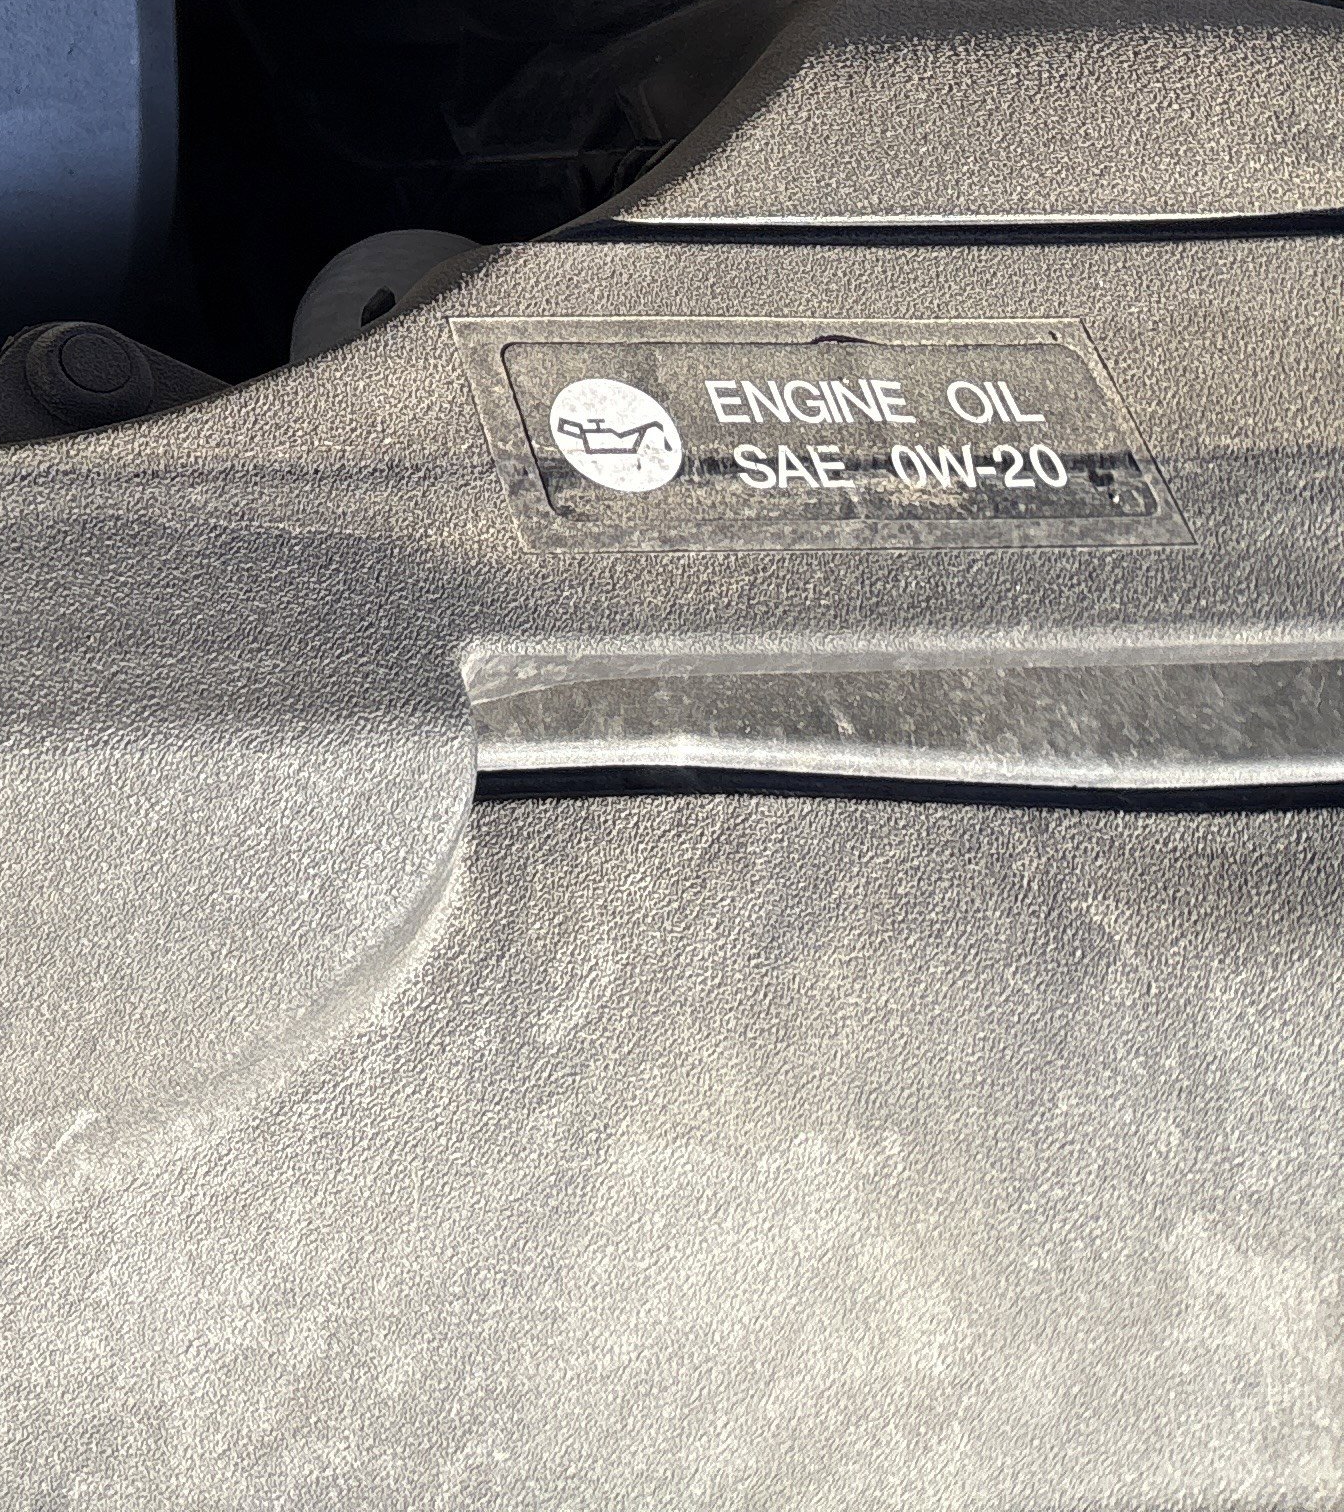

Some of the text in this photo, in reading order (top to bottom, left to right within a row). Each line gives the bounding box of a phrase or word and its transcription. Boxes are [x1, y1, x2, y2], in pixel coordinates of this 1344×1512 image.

[704, 378, 1045, 424] ENGINE OIL
[733, 443, 1069, 489] SAE 0W-20
